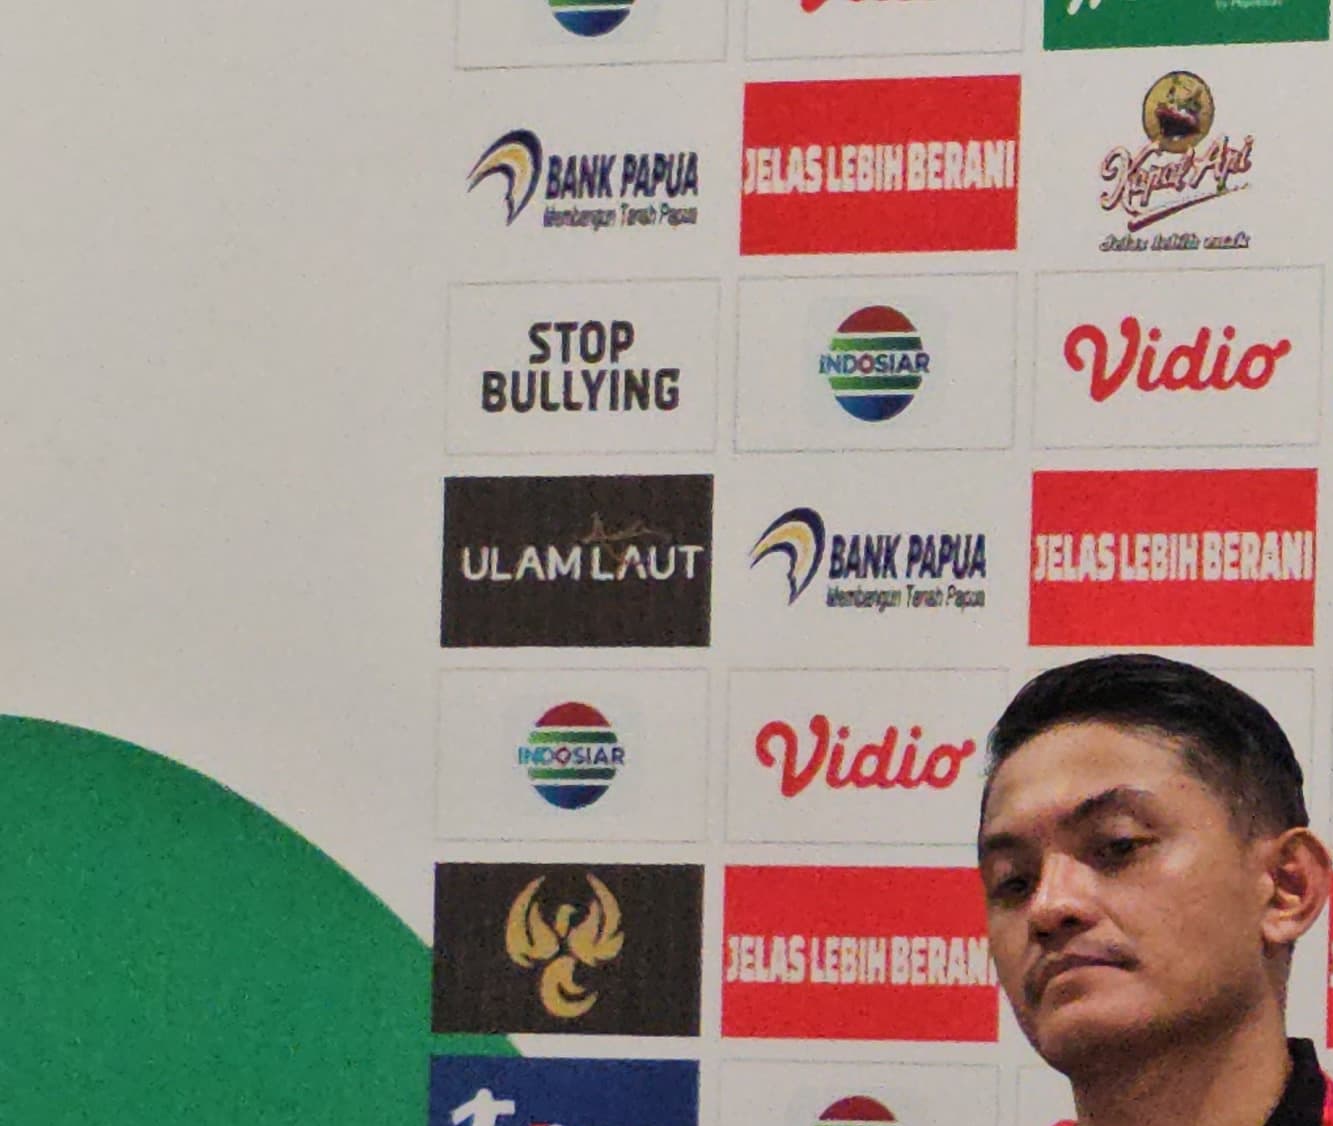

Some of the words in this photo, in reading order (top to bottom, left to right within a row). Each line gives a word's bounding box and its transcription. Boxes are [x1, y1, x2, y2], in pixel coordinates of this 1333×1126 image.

[546, 154, 612, 199] BANK
[620, 152, 698, 197] PAPUA
[744, 147, 821, 195] JELAS
[827, 146, 900, 193] LEBIH
[907, 141, 1015, 190] BERANI
[529, 321, 635, 363] STOP
[819, 353, 930, 374] INDOSIAR
[1064, 316, 1290, 403] Vidio
[482, 368, 681, 413] BULLYING
[462, 546, 580, 582] ULAM
[591, 546, 703, 580] LAUT
[830, 535, 898, 578] BANK
[905, 534, 986, 578] PAPUA
[1033, 536, 1114, 582] JELAS
[1120, 533, 1197, 581] LEBIH
[1204, 531, 1313, 581] BERANI
[518, 746, 624, 765] INDOSIAR
[755, 715, 975, 797] Vidio
[727, 938, 805, 983] JELAS
[810, 937, 886, 983] LEBIH
[893, 937, 996, 986] BERAN
